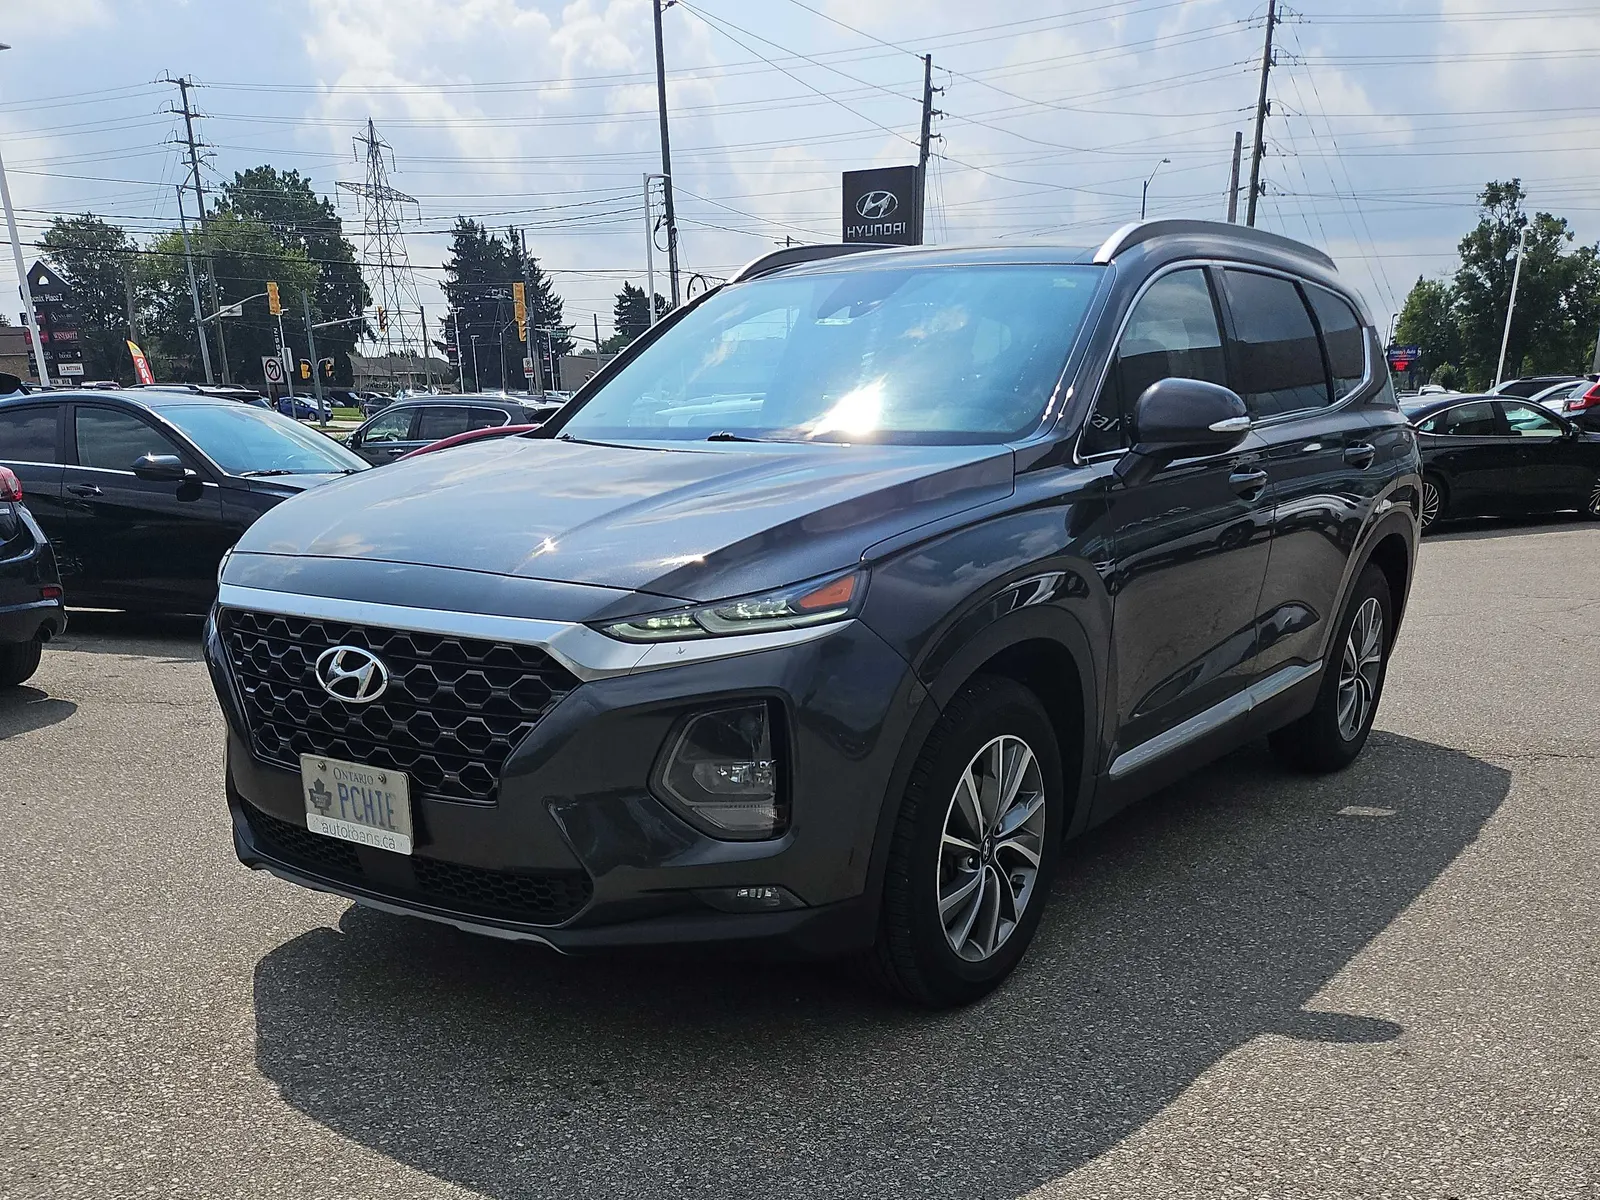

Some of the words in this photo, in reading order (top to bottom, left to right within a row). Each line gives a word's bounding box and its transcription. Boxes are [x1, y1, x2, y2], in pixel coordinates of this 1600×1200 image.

[847, 222, 906, 238] HYUNDAI
[333, 767, 374, 786] ONTARIO
[321, 821, 396, 850] autoloans.ca
